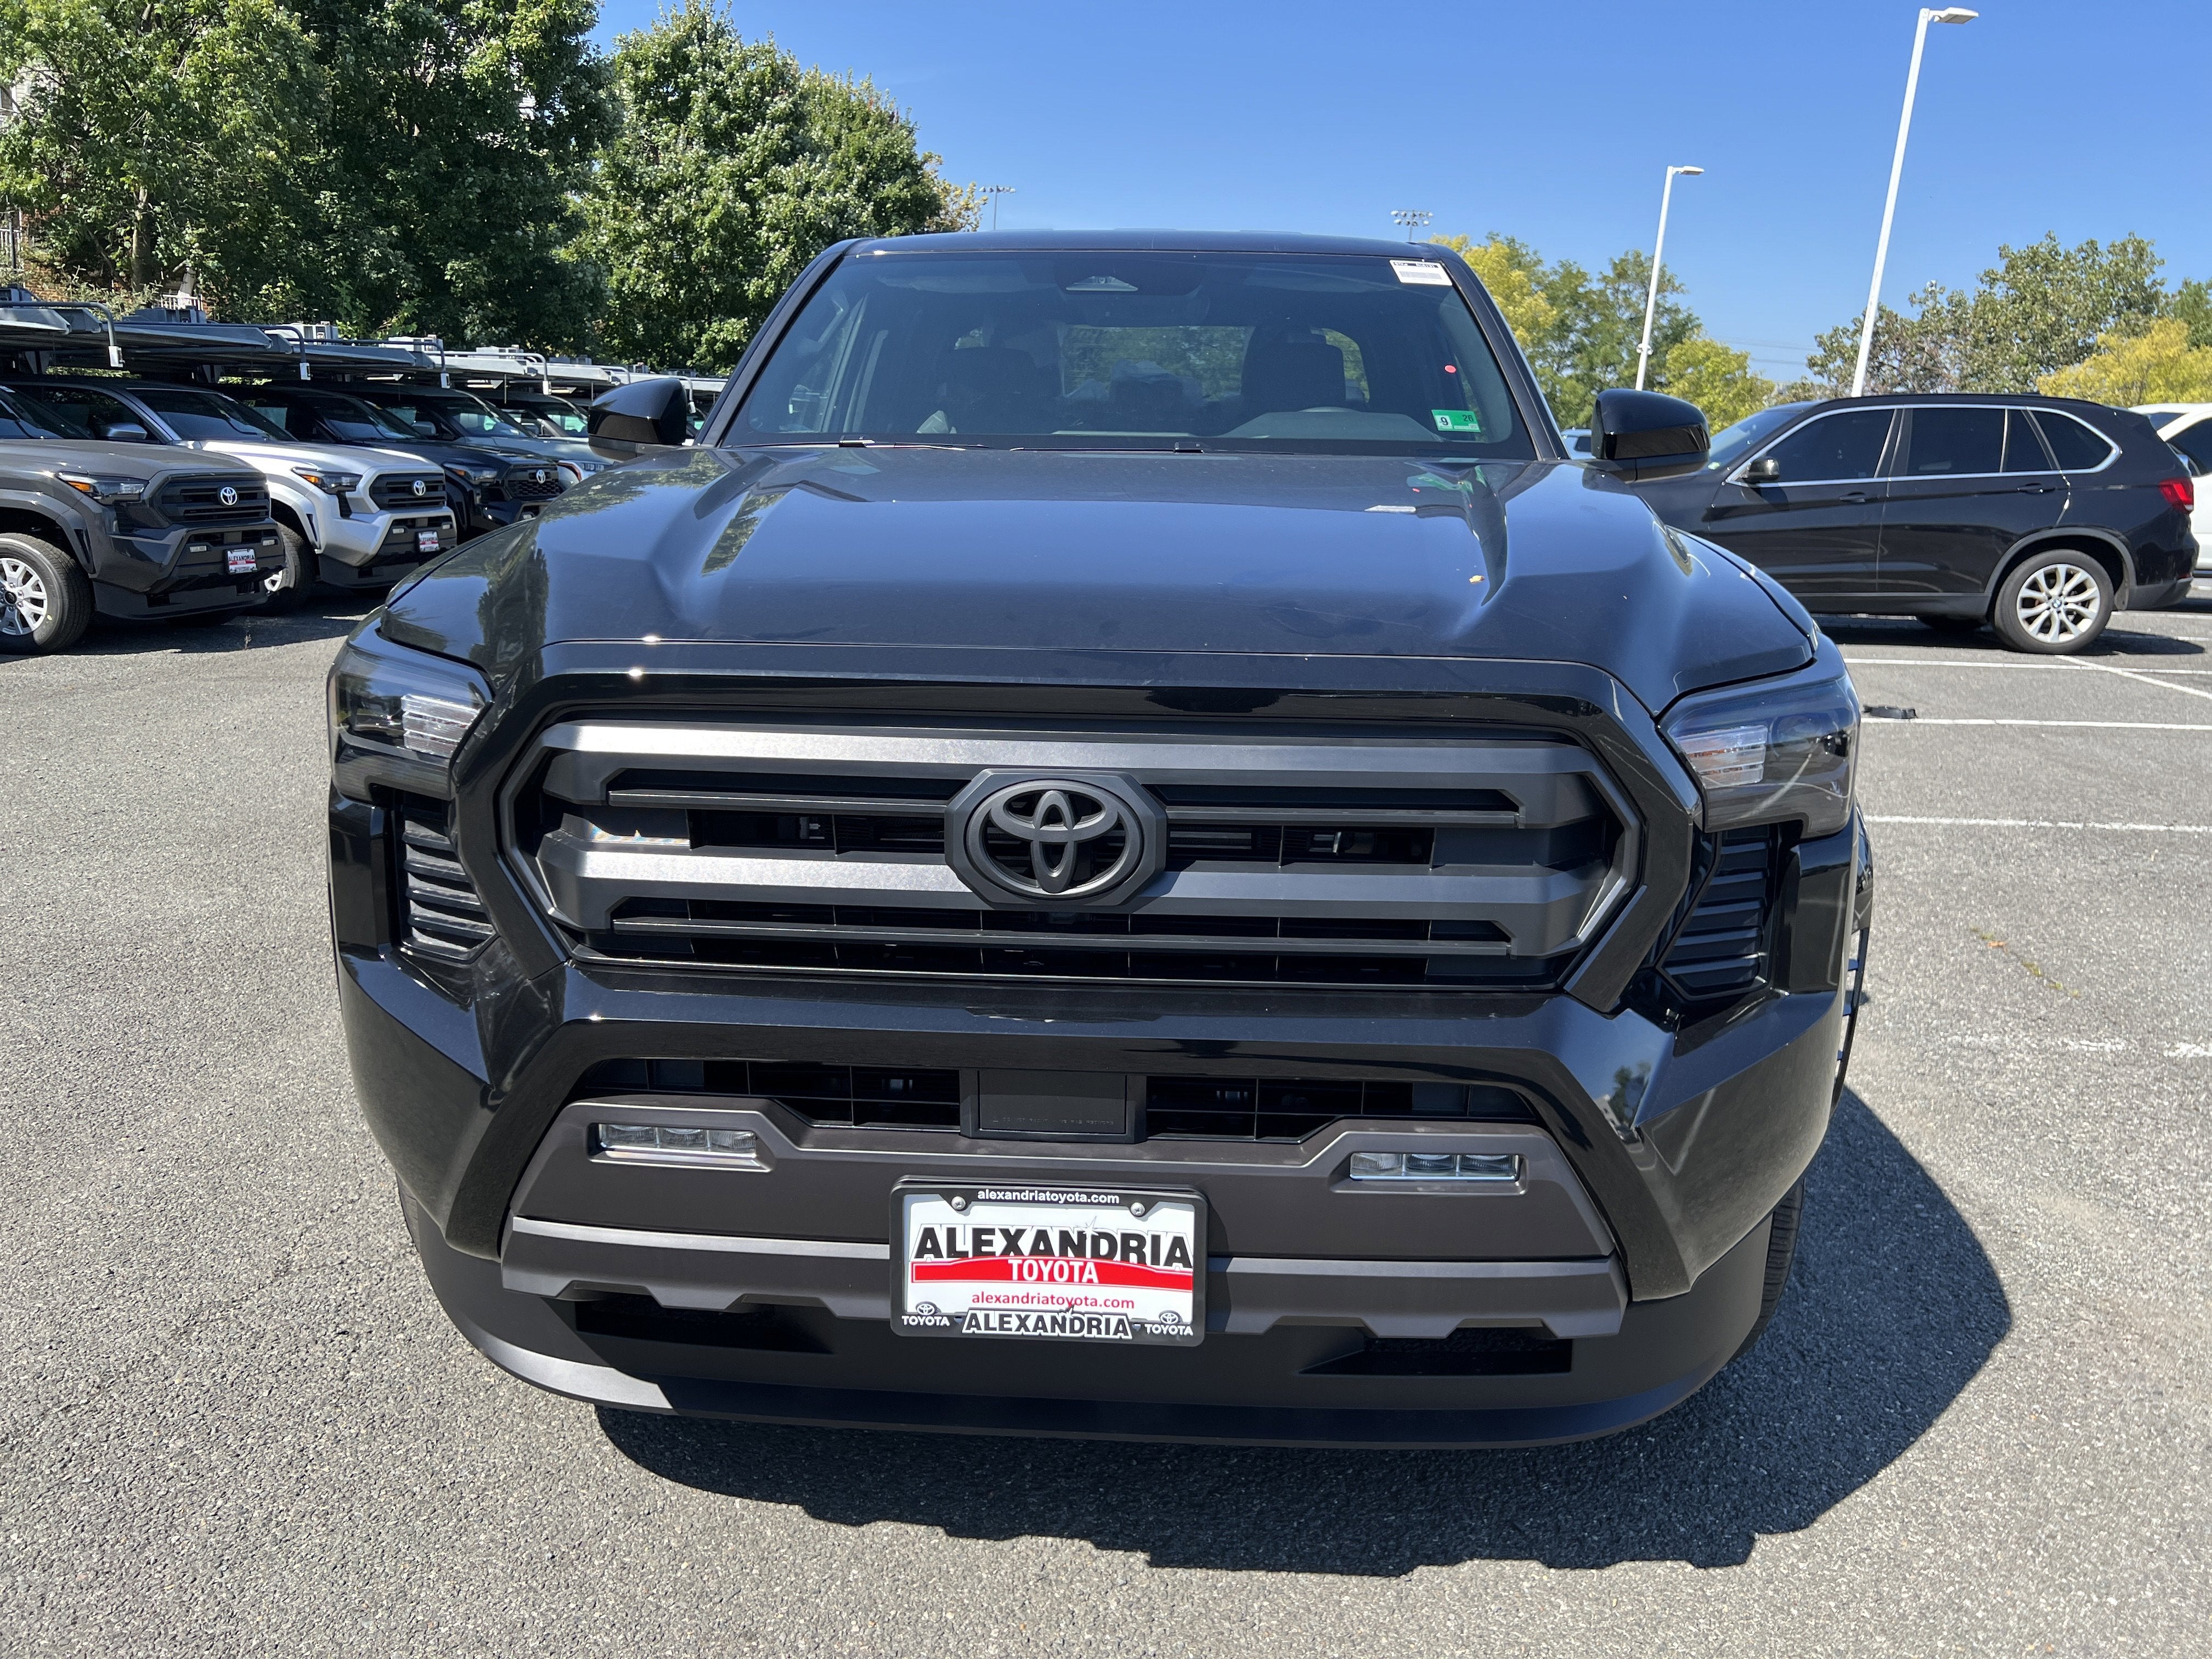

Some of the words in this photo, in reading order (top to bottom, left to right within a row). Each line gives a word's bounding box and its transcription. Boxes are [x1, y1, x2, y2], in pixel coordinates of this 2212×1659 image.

[1440, 417, 1448, 426] 9
[977, 1189, 1120, 1204] alexandriatoyota.com
[914, 1226, 1193, 1269] ALEXANDRIA
[1008, 1259, 1099, 1283] TOYOTA
[972, 1291, 1135, 1309] alexandriatoyota.com
[901, 1316, 950, 1327] TOYOTA
[963, 1310, 1131, 1339] ALEXANDRIA
[1144, 1324, 1194, 1336] TOYOTA
